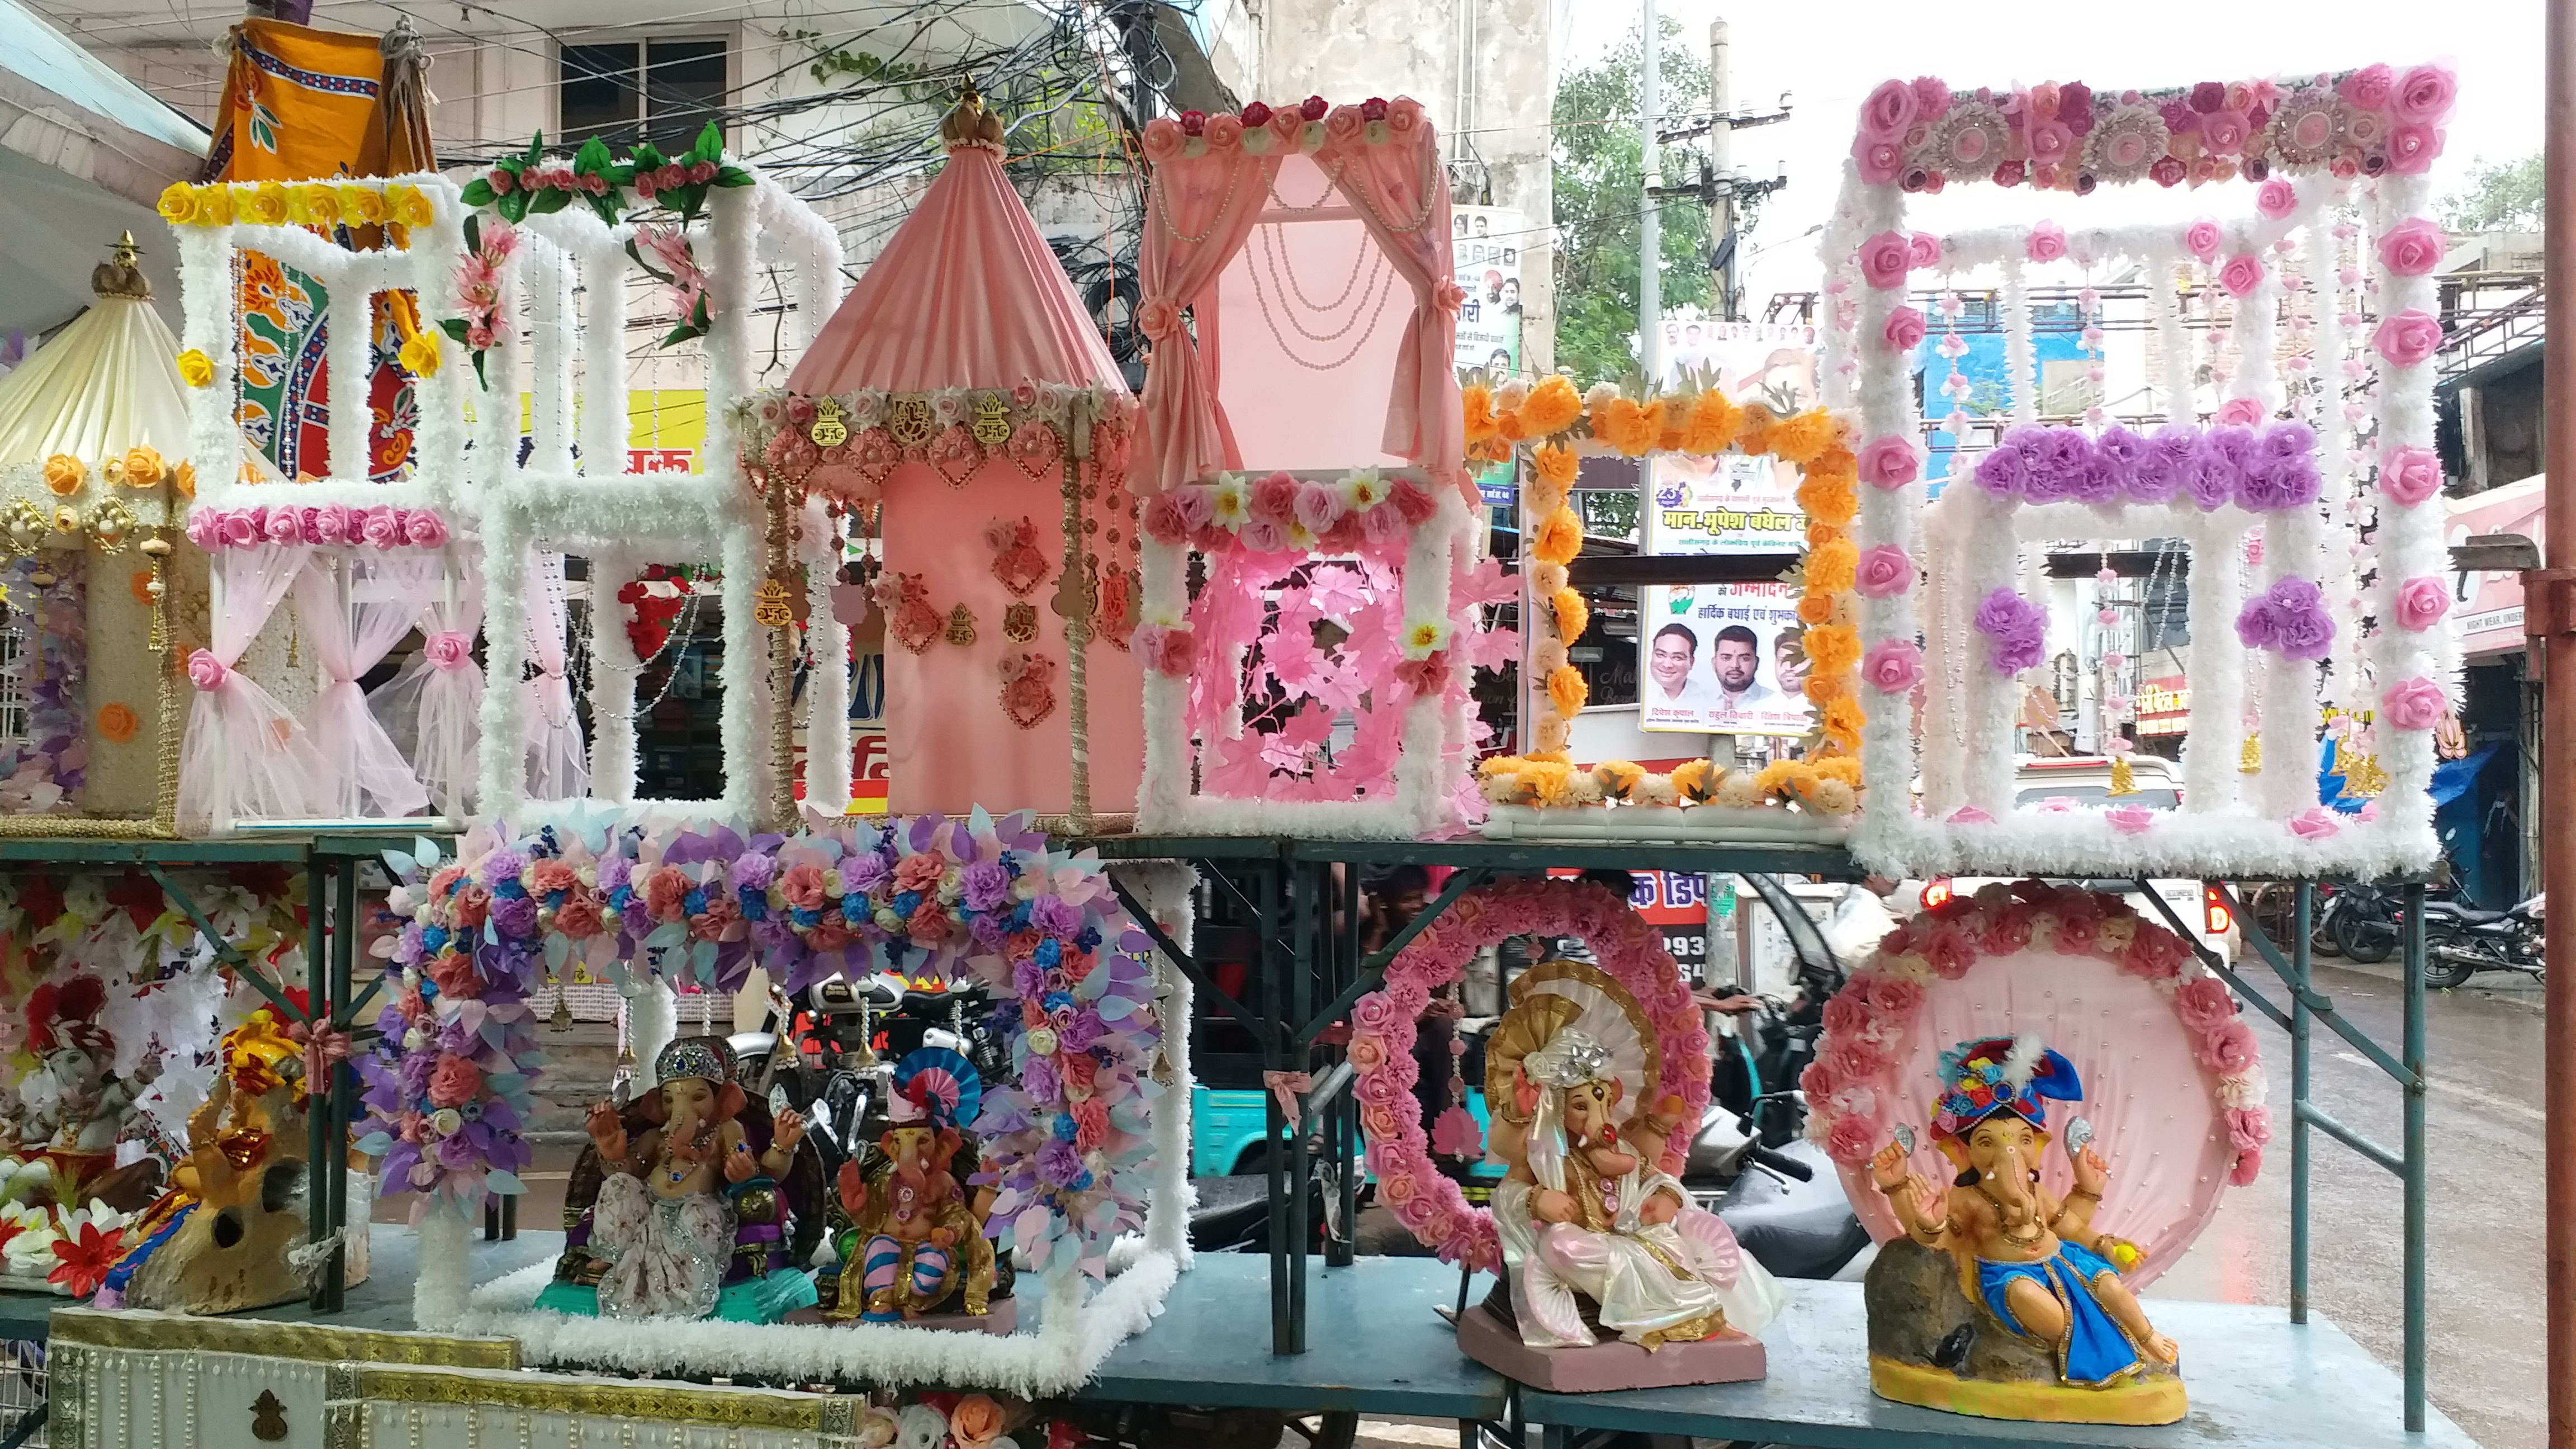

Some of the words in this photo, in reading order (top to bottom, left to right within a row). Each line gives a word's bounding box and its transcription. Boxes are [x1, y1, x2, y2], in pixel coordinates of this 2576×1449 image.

[1658, 484, 1677, 499] 23
[1748, 506, 1793, 531] बघेल
[1698, 604, 1725, 619] हार्दिक
[1727, 605, 1750, 621] बधाई
[1753, 605, 1768, 621] एवं
[1769, 609, 1800, 626] शुभका
